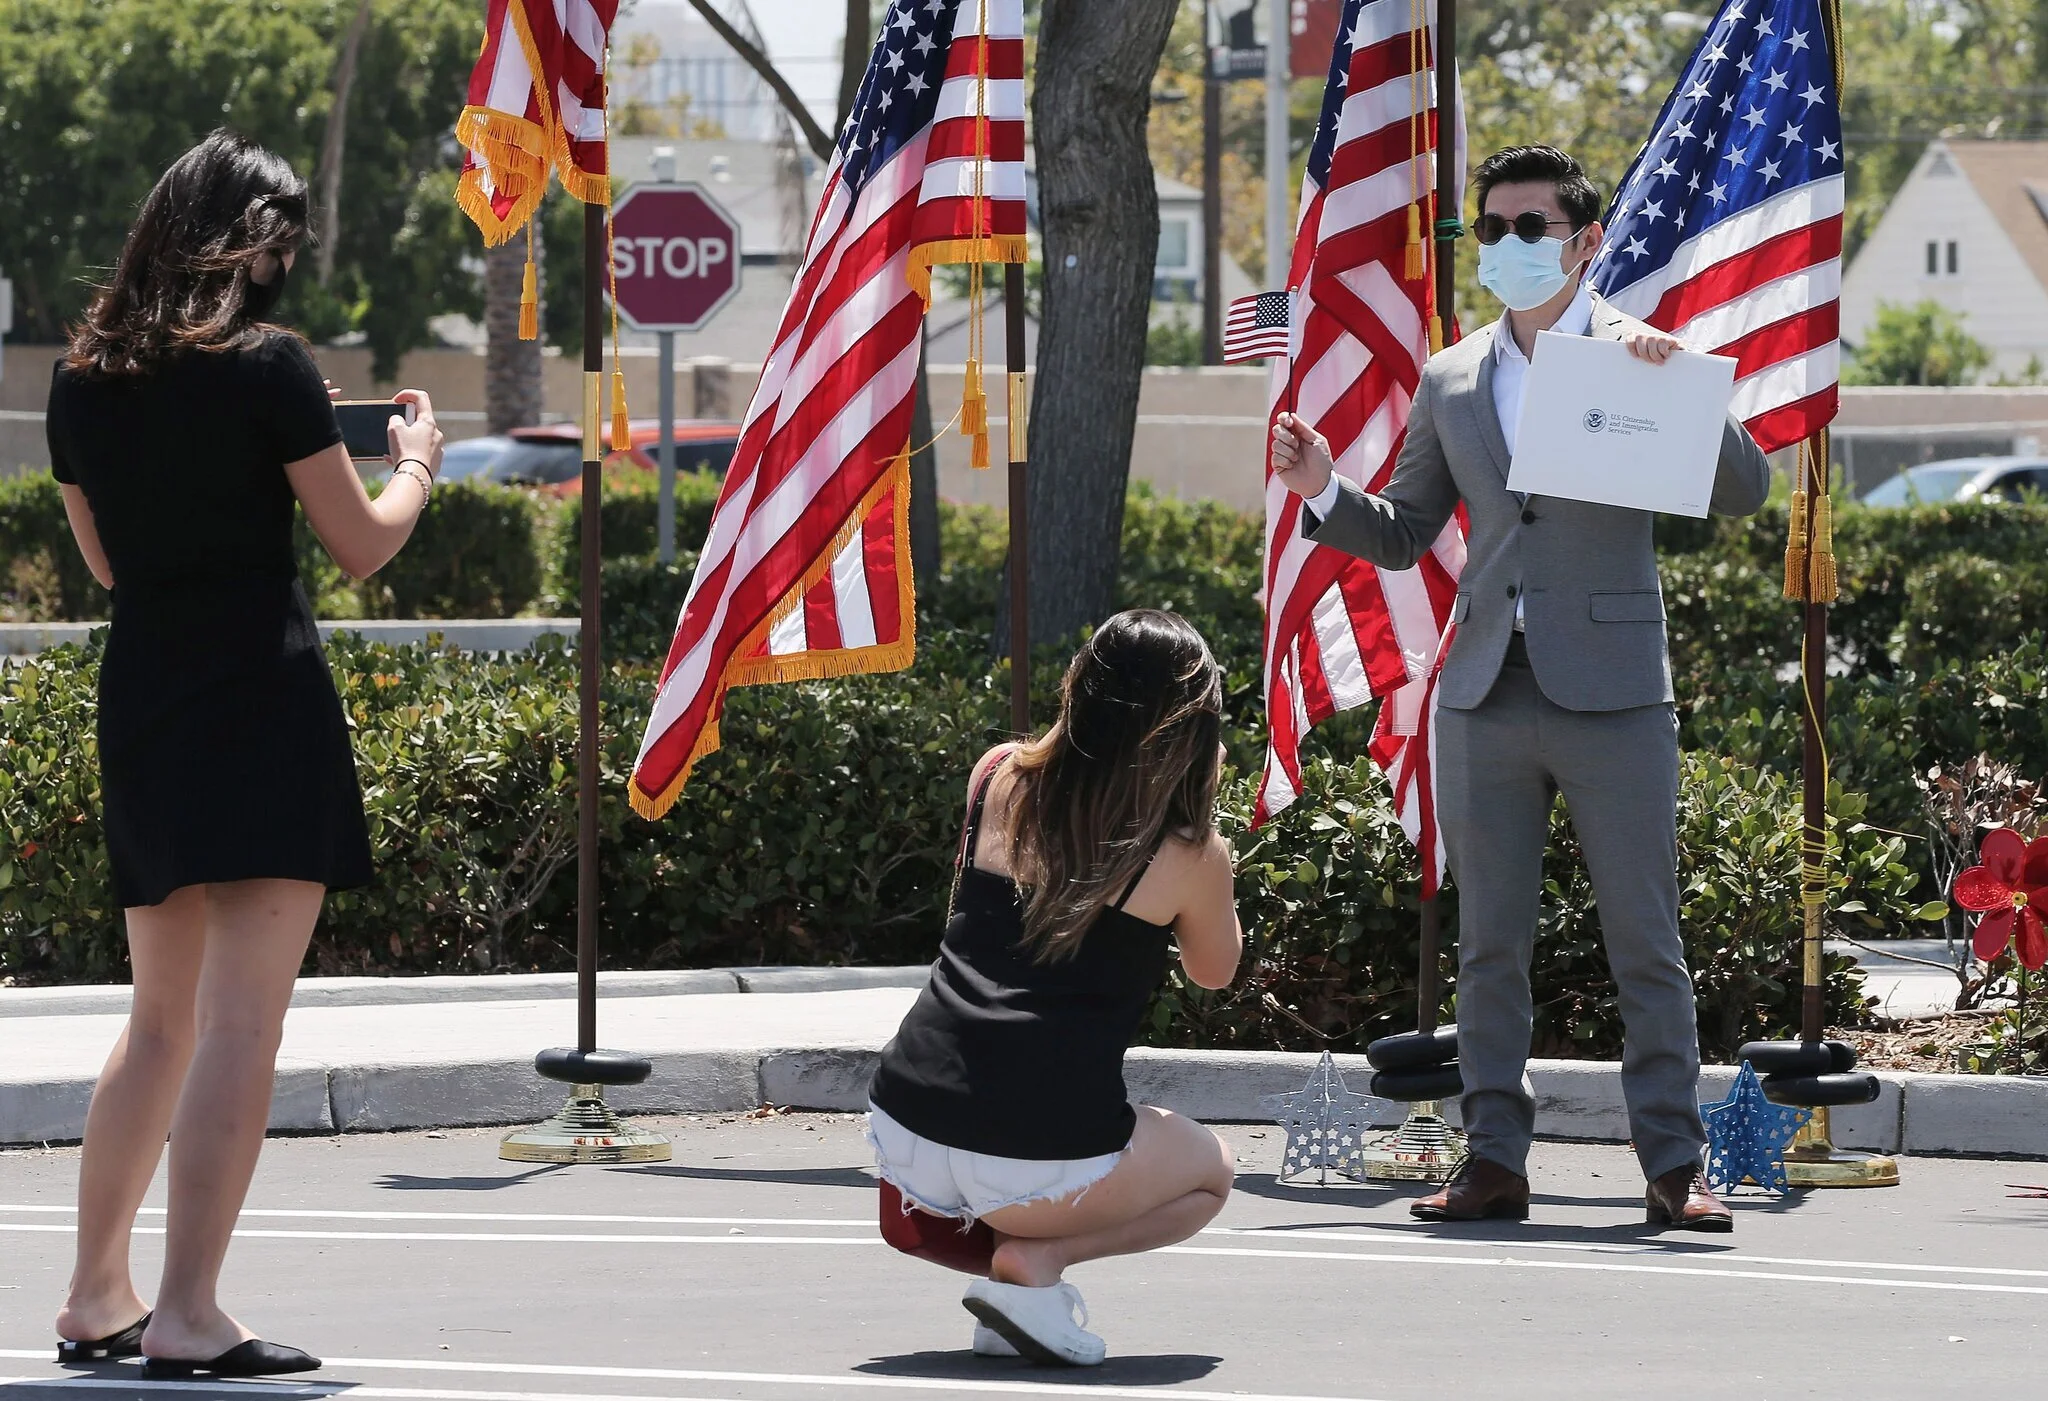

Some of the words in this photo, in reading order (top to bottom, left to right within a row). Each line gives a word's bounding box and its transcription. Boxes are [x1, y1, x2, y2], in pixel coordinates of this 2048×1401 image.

[606, 236, 728, 279] STOP
[1622, 416, 1656, 427] Citizenship
[1608, 427, 1631, 436] Services
[1622, 422, 1659, 432] Immigration
